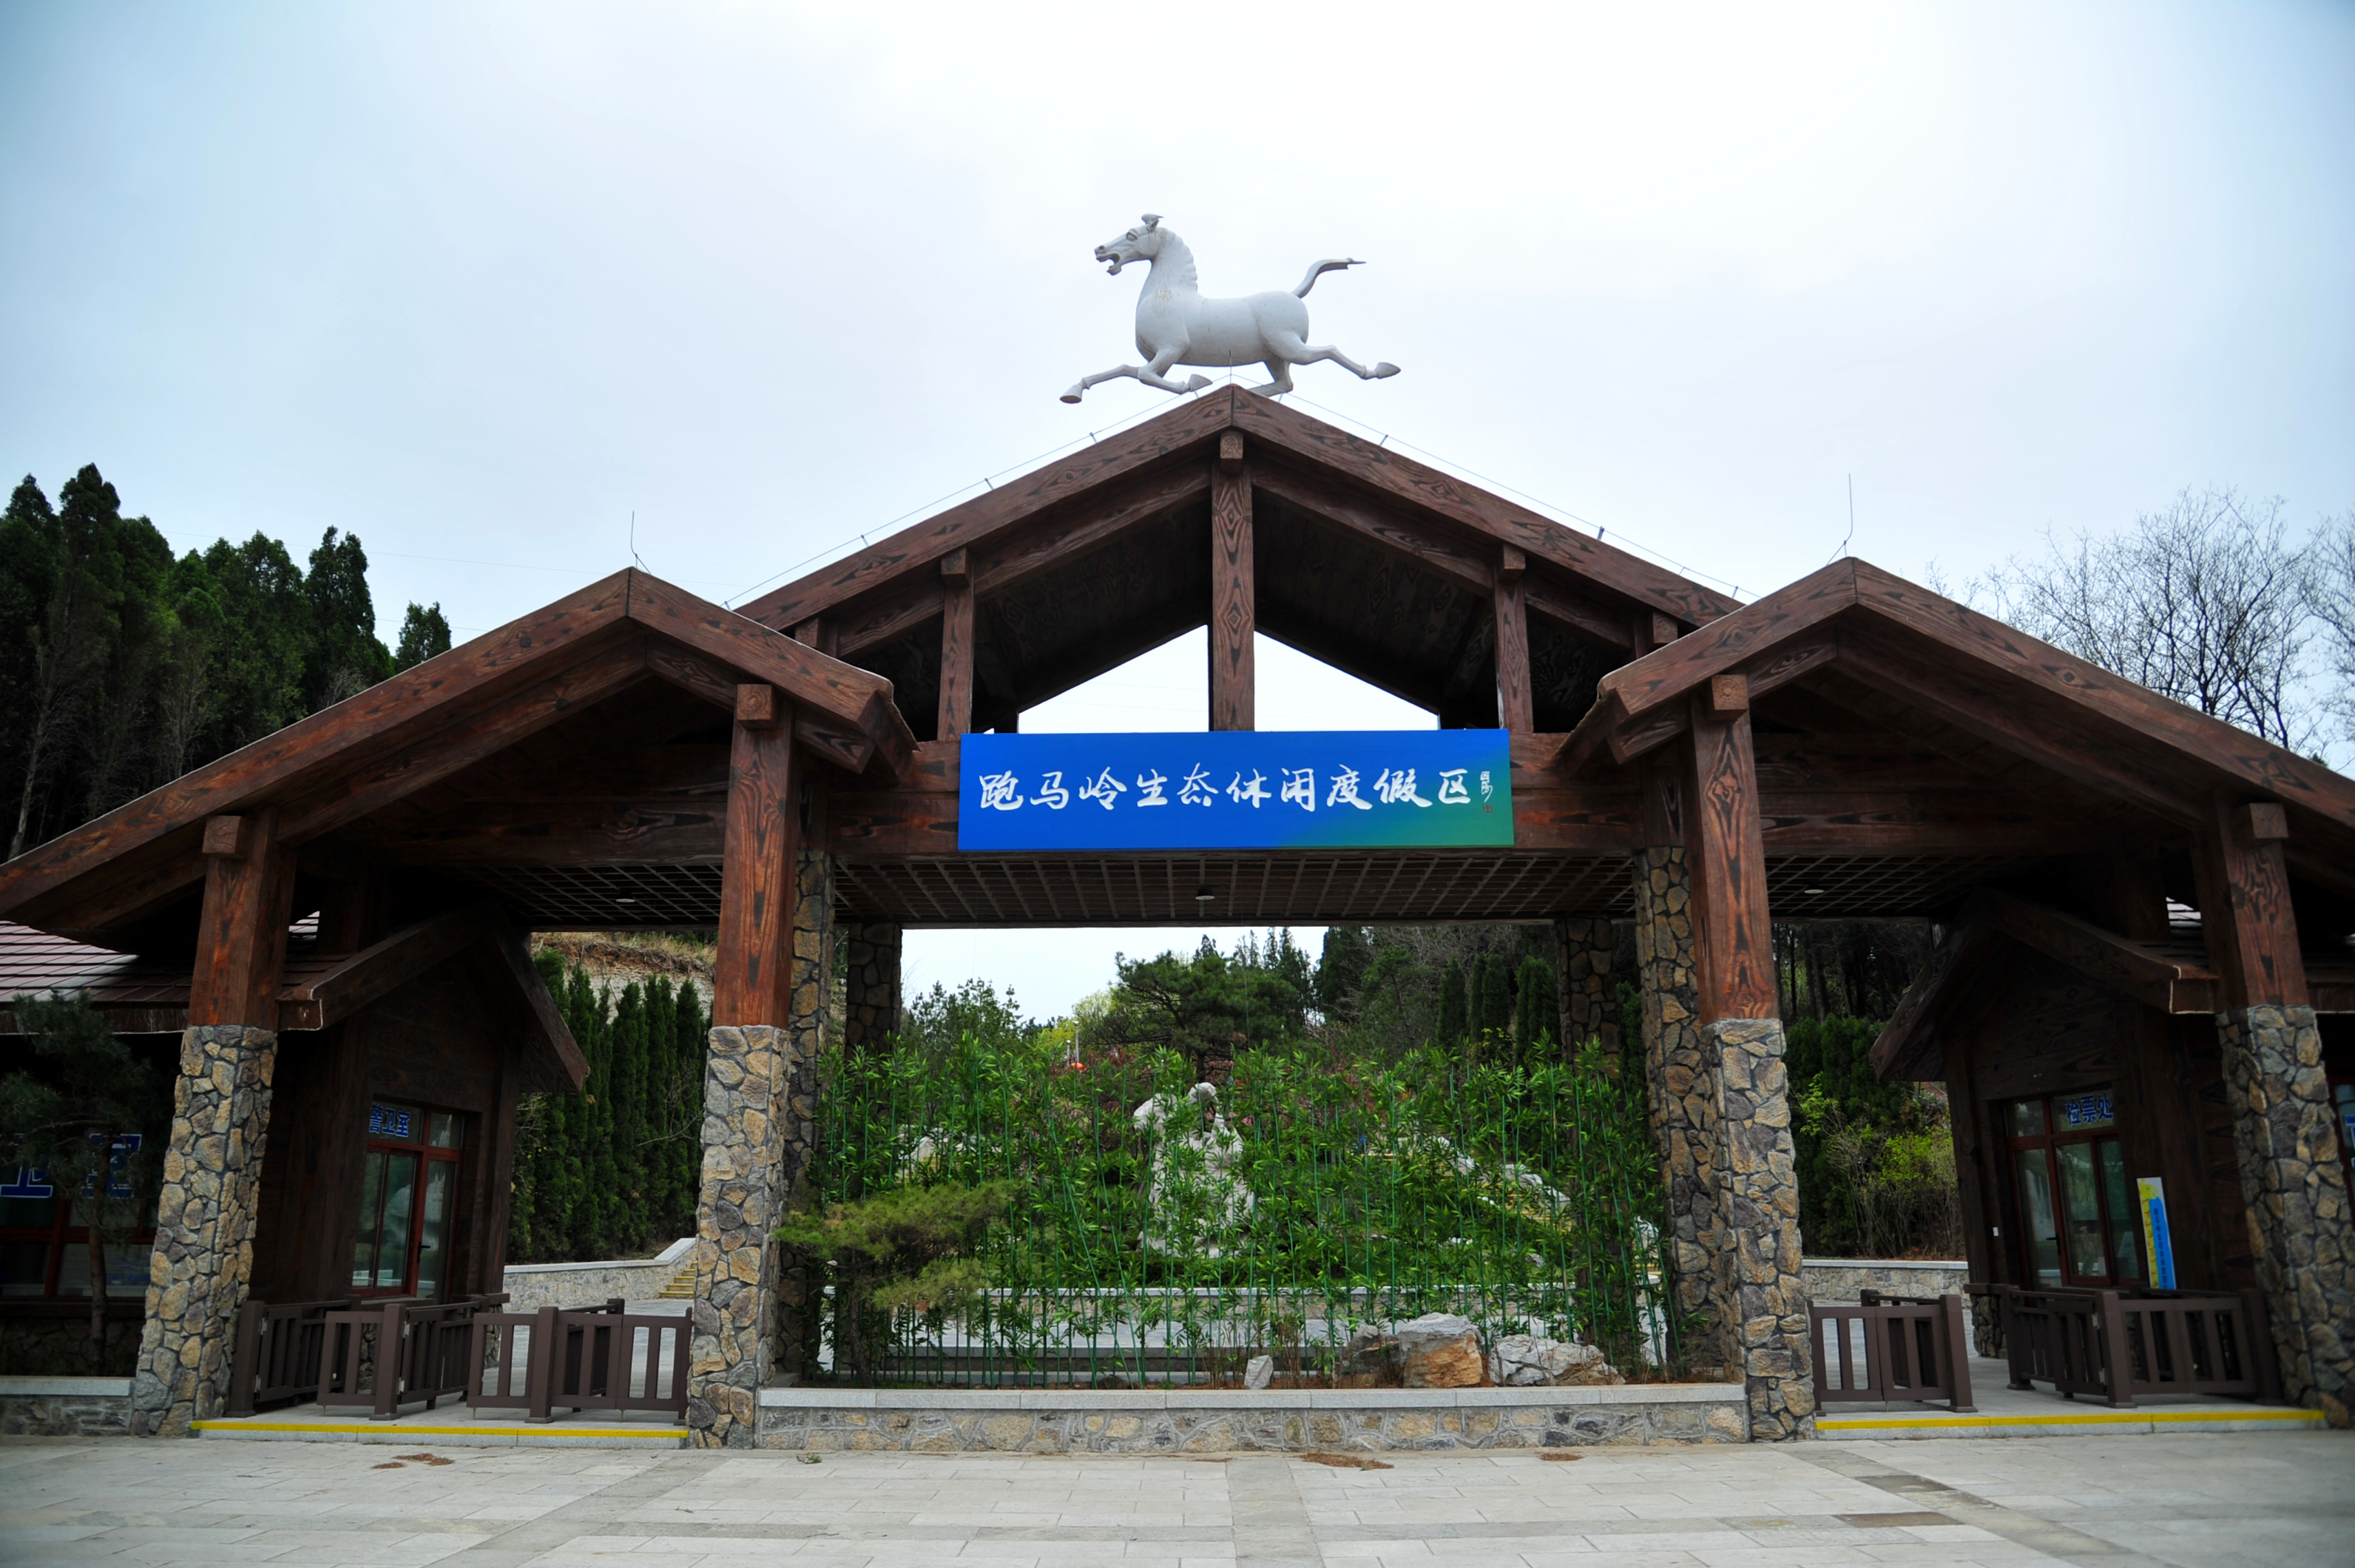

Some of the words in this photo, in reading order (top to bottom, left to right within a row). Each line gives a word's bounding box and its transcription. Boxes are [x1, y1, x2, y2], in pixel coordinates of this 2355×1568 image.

[979, 762, 1471, 812] 跑马岭生态休闲度假区
[370, 1103, 410, 1138] 警卫室
[2065, 1093, 2114, 1126] 检票处
